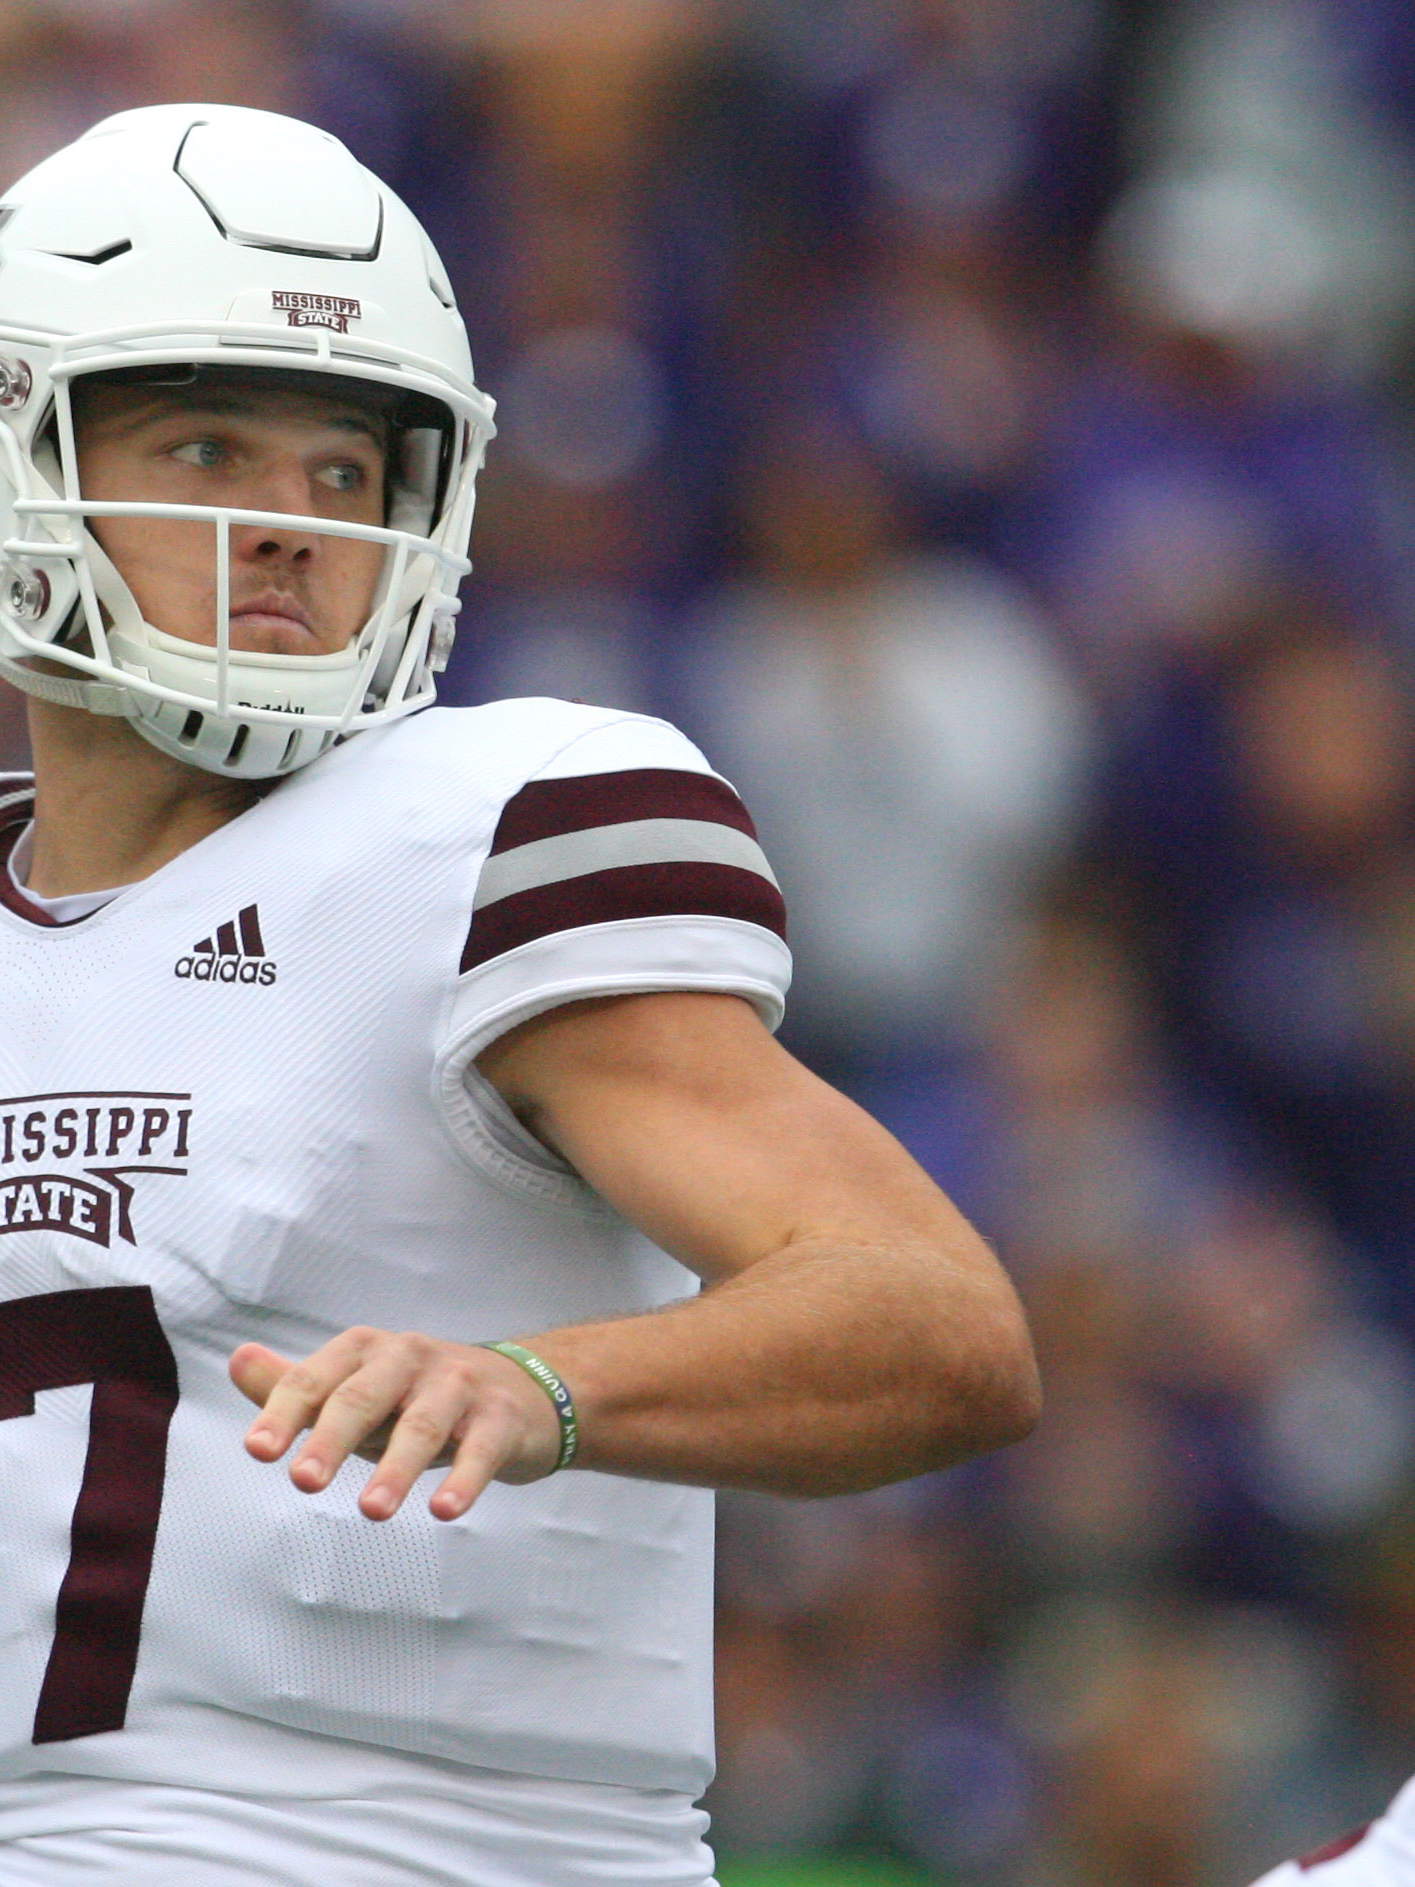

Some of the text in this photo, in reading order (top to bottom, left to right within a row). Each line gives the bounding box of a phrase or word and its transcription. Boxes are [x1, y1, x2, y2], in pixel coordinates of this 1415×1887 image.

[272, 294, 361, 315] MISSISSIPPI
[298, 312, 340, 329] STATE
[174, 951, 277, 986] adidas
[526, 1358, 567, 1402] QUINN
